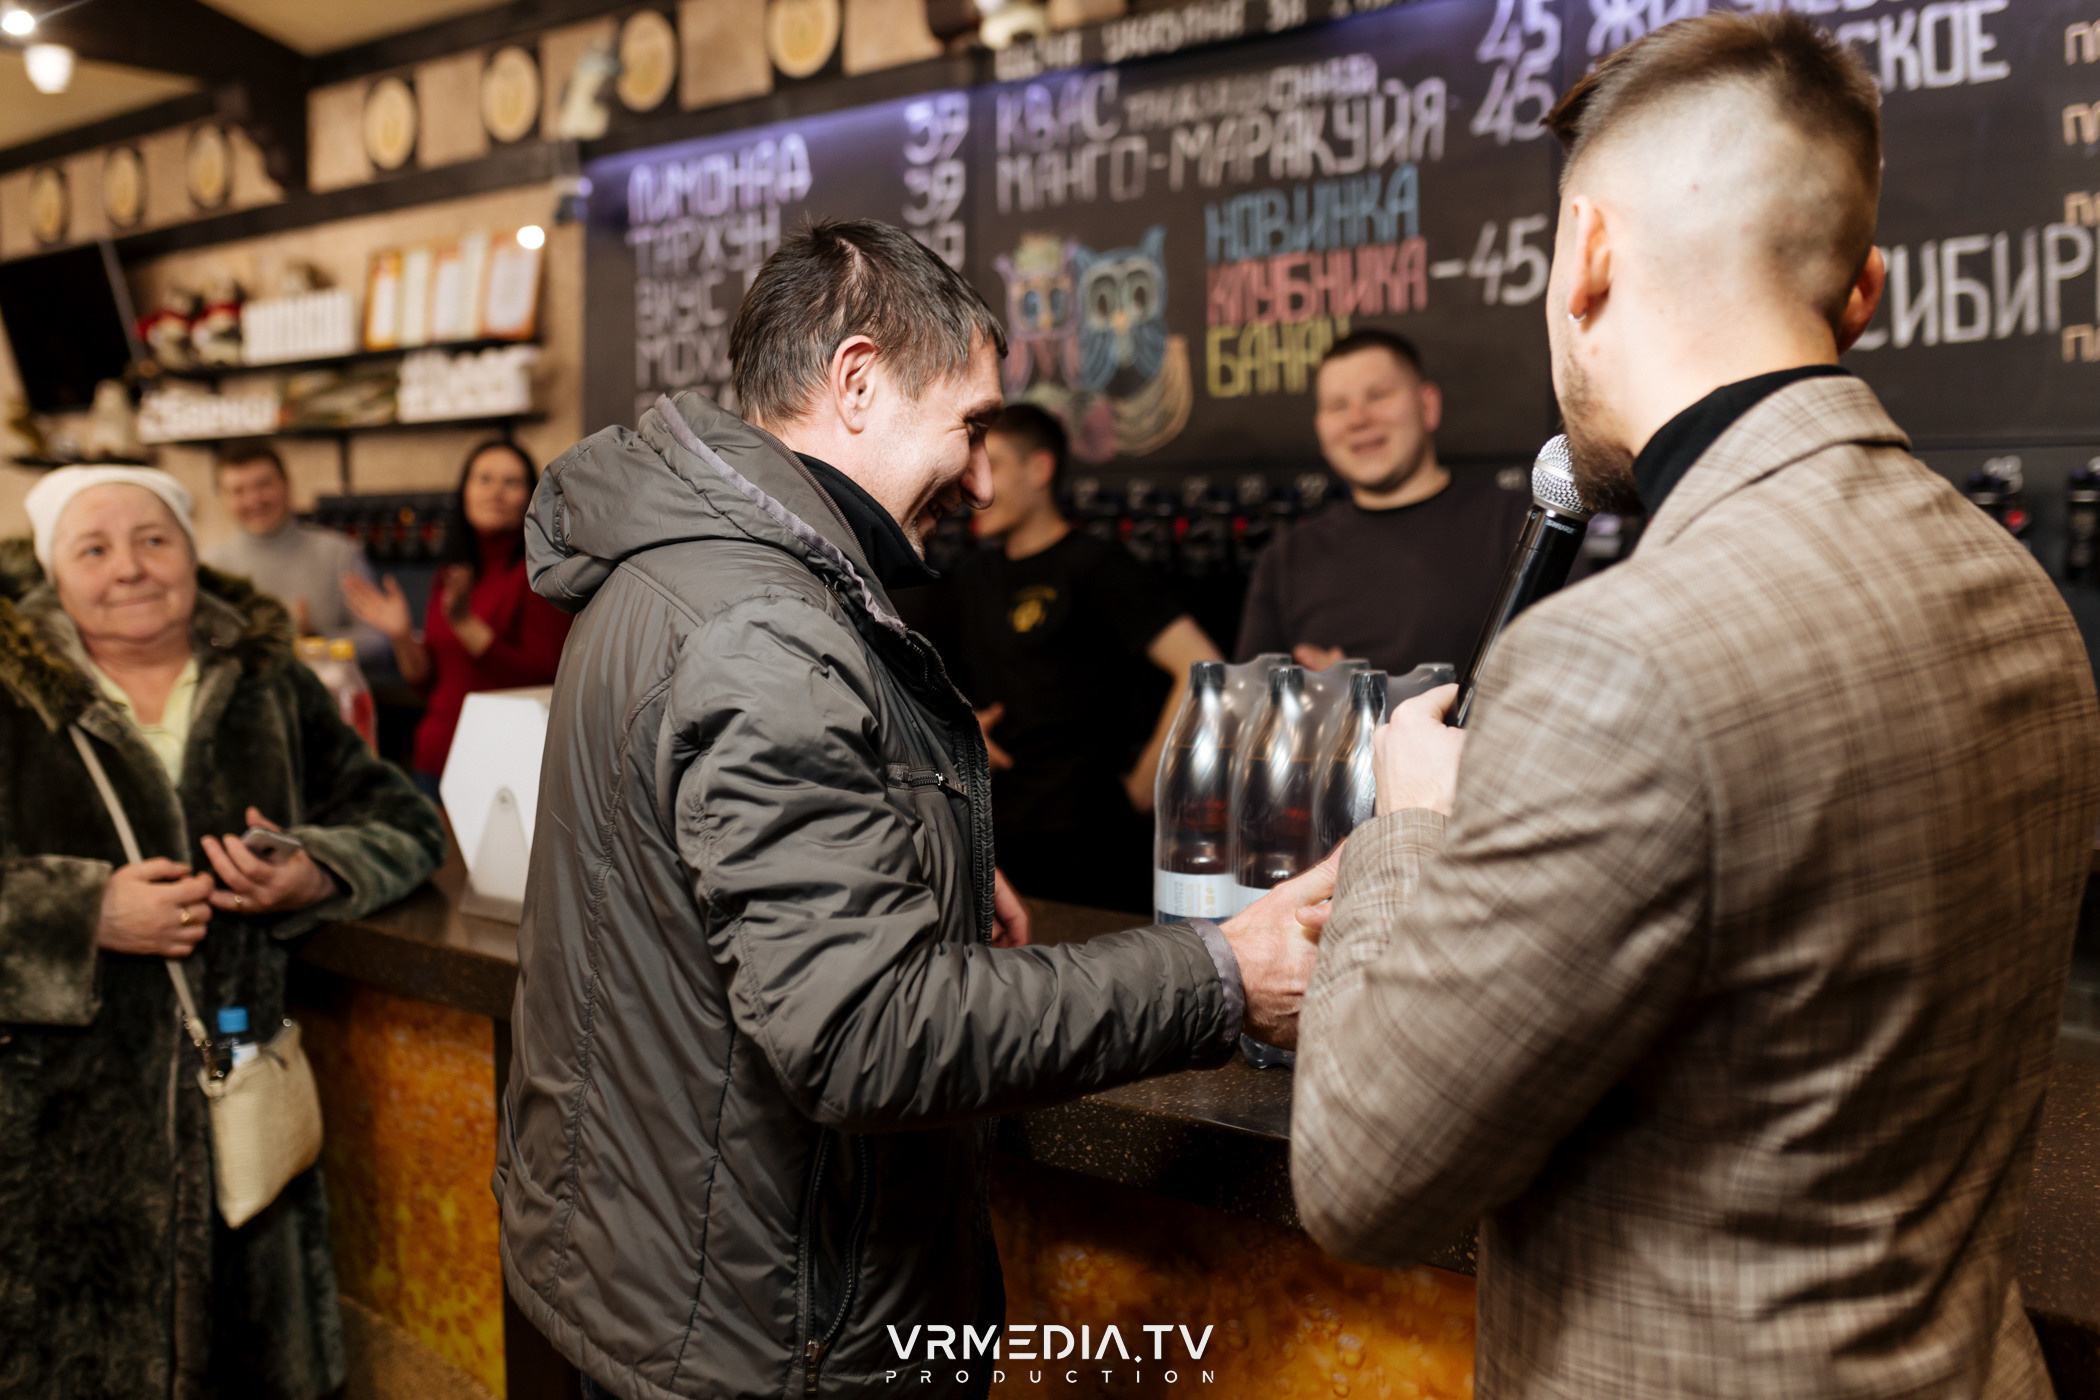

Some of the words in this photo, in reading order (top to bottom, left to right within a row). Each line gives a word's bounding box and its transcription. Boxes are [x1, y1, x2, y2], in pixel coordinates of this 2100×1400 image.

[996, 68, 1122, 153] КВАС
[1205, 163, 1419, 266] НОВИНКА
[1206, 235, 1428, 328] КЛУБНИКА
[1206, 314, 1350, 397] БАНА
